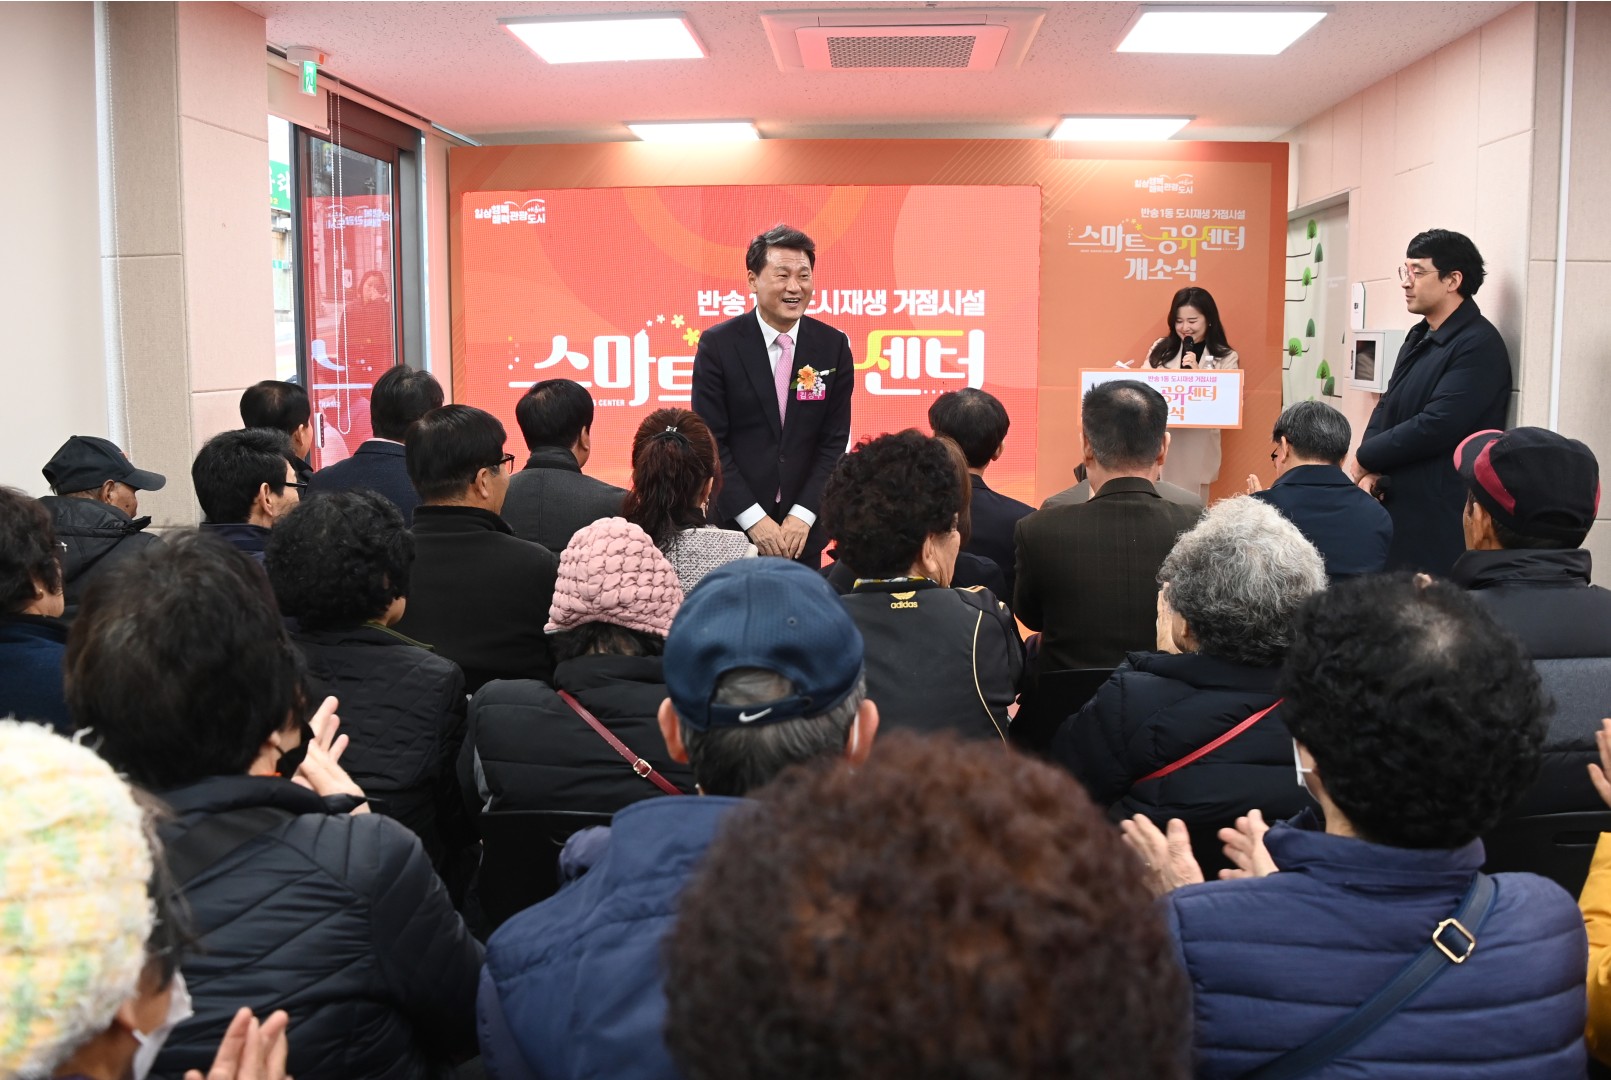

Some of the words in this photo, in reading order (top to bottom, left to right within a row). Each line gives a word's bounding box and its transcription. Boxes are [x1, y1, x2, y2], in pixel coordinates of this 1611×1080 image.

[1175, 208, 1211, 219] 도시재생
[1212, 209, 1246, 220] 거점시설
[1068, 223, 1154, 253] 스마트
[1124, 257, 1197, 281] 개소식
[893, 289, 985, 316] 거점시설
[598, 399, 625, 407] CENTER
[890, 600, 919, 609] adidas
